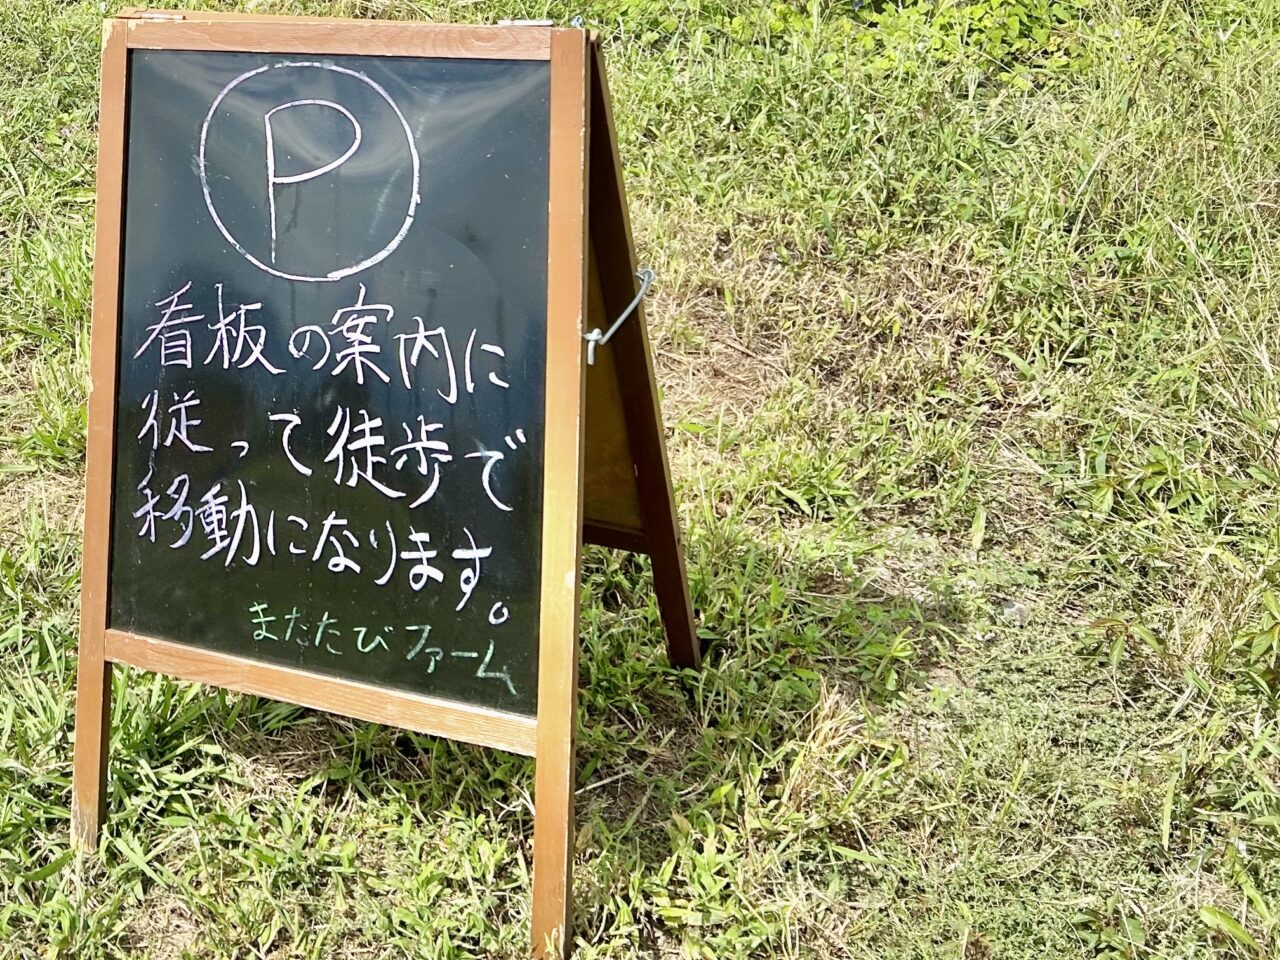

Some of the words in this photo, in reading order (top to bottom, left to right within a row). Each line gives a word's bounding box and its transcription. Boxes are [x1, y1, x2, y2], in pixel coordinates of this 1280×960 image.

[264, 99, 362, 265] P
[133, 280, 511, 404] 看板の案内に
[136, 387, 528, 512] 従って徒歩で
[132, 466, 511, 626] 移動になります。
[248, 601, 520, 696] またたびファーム
